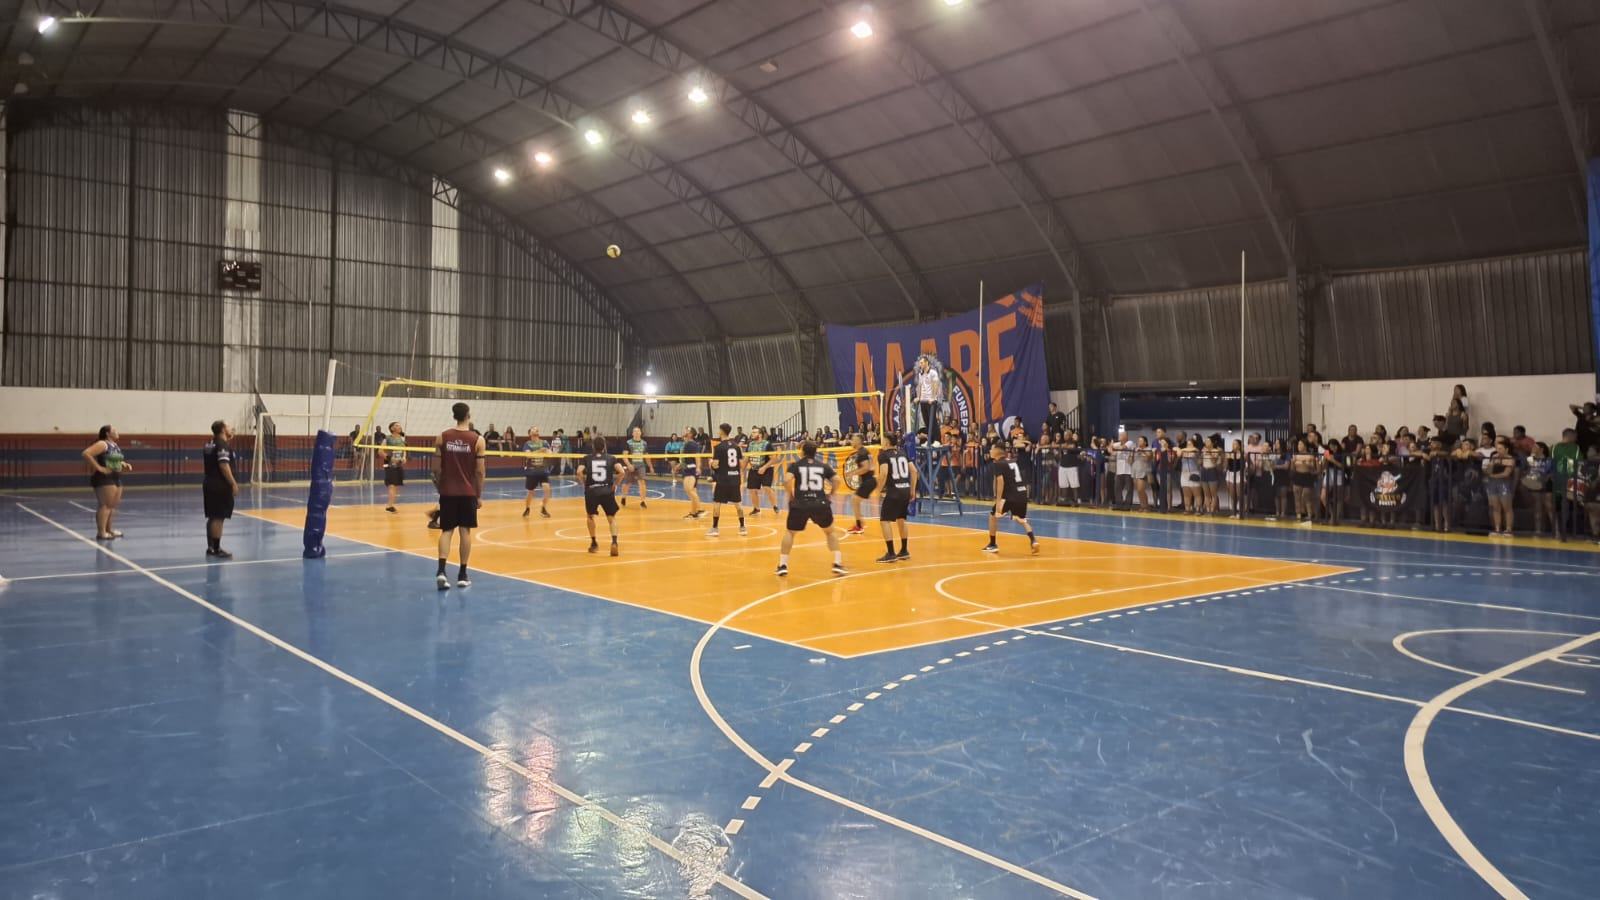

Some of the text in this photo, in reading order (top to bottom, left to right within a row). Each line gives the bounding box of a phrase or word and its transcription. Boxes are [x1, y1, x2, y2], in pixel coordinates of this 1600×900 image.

[727, 448, 737, 467] 8
[591, 460, 607, 481] 5
[799, 466, 824, 491] 15
[889, 457, 909, 480] 10
[1008, 462, 1022, 482] 7
